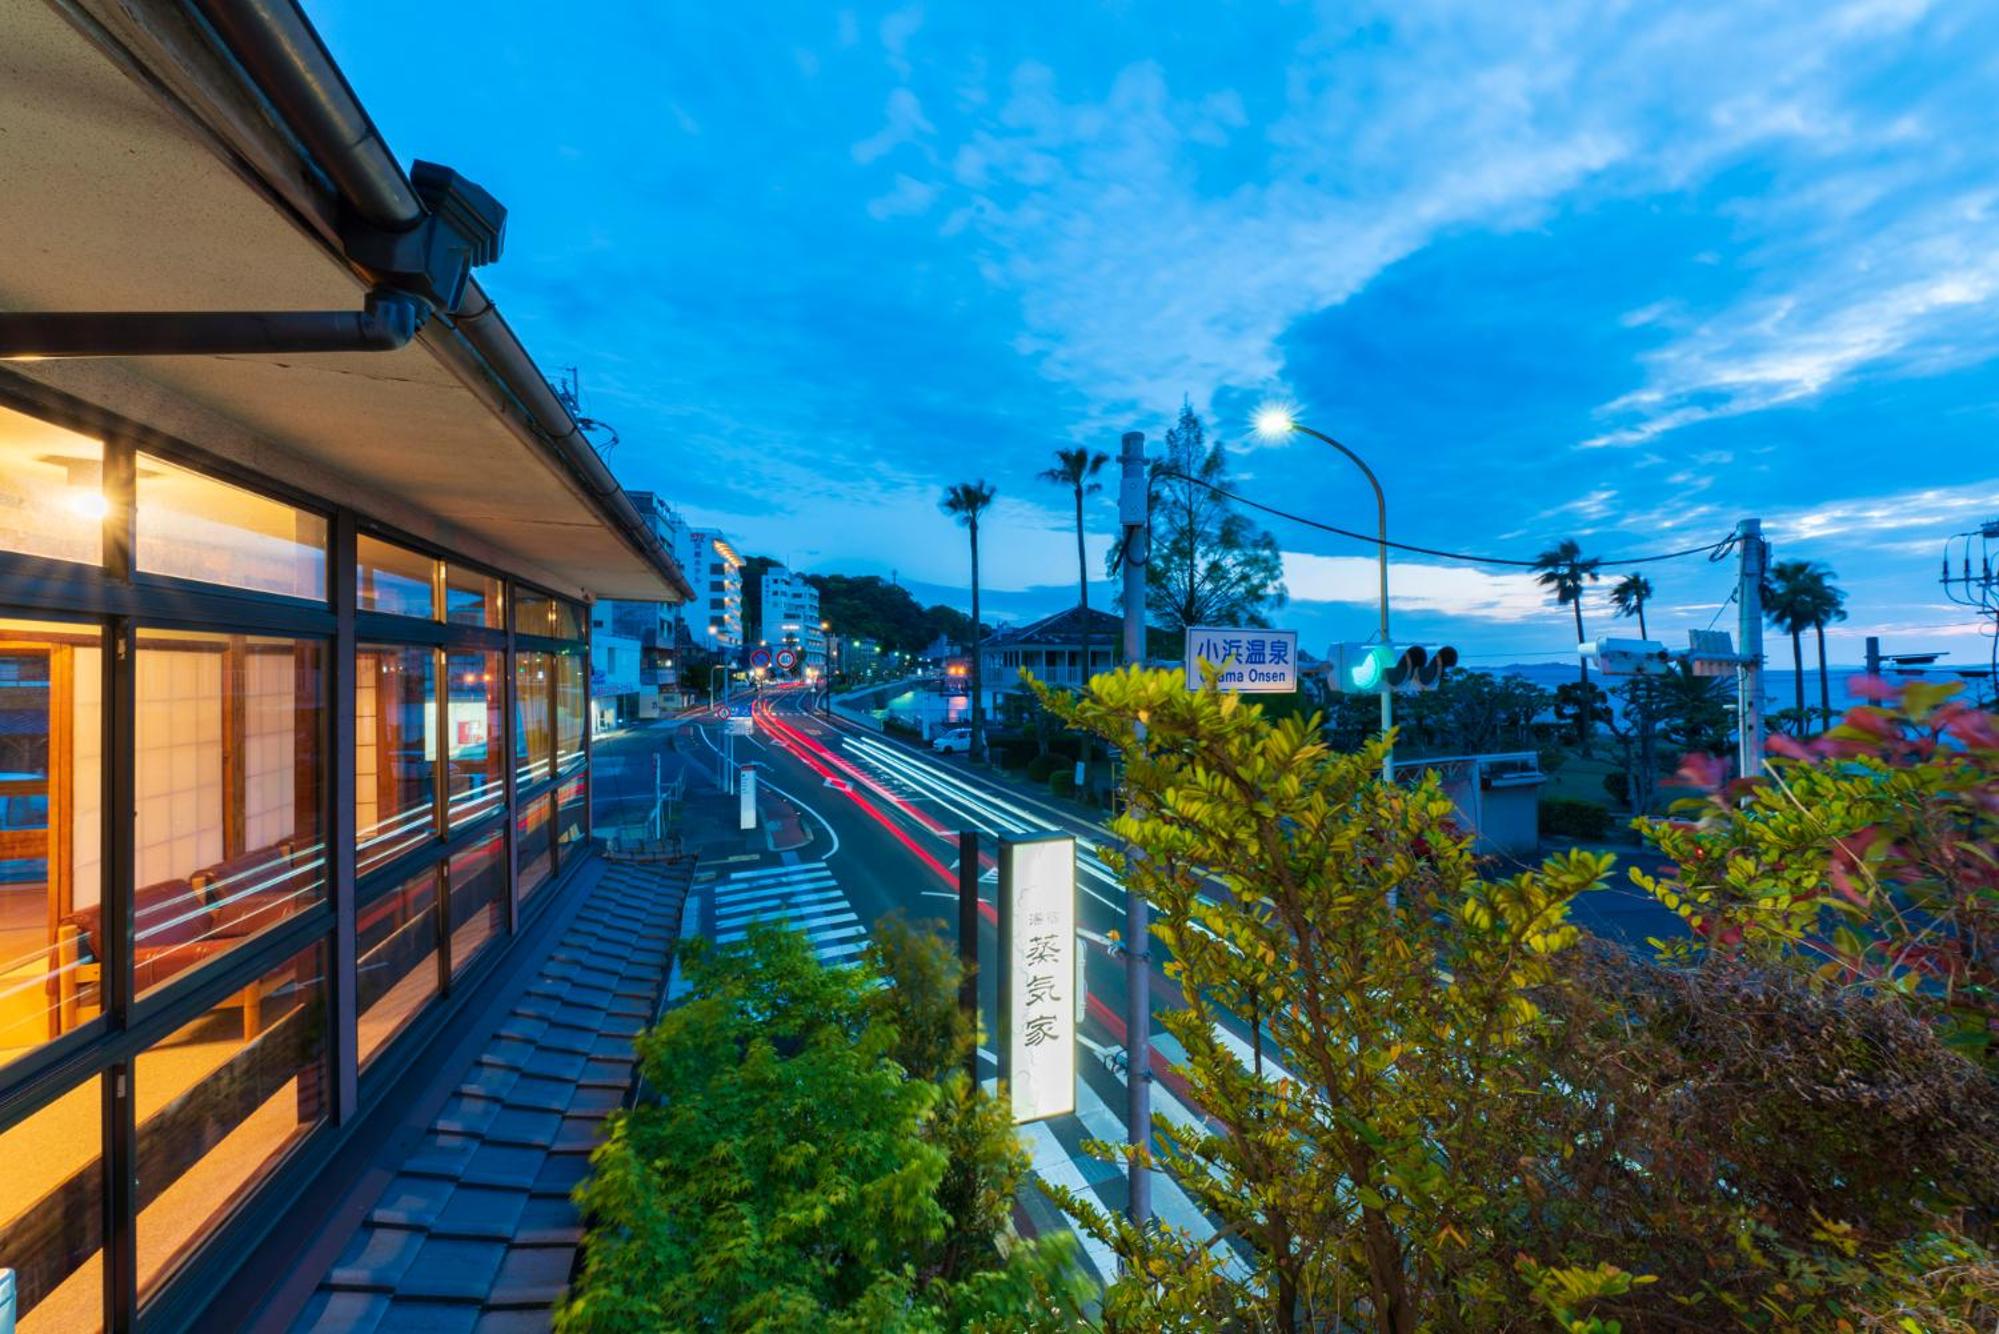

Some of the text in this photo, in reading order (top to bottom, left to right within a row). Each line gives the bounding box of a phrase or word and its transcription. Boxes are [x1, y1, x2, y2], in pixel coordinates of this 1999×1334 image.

[1196, 638, 1290, 665] 小浜温泉
[1249, 668, 1286, 682] Onsen
[1024, 934, 1061, 1047] 蒸気家
